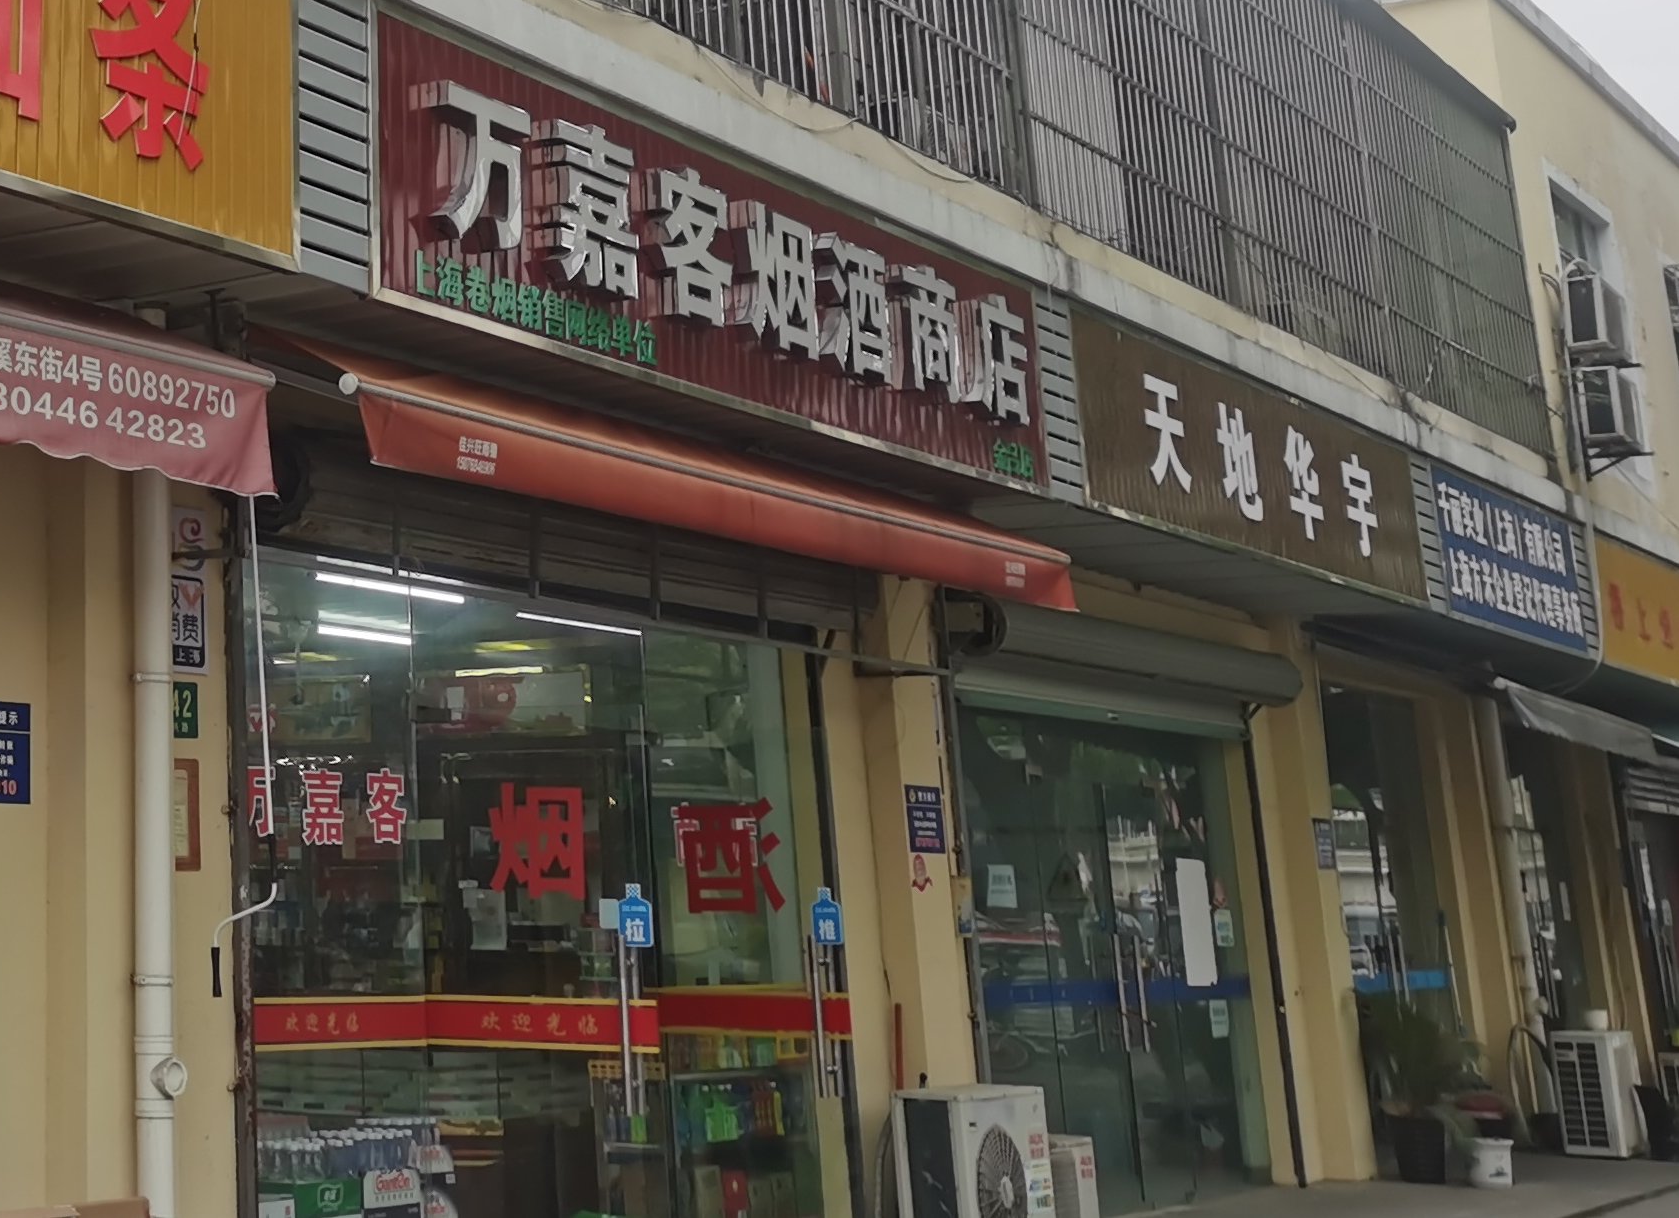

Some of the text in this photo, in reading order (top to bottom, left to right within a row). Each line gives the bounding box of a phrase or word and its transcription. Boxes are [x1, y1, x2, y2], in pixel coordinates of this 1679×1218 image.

[421, 80, 1032, 426] 万嘉客烟酒商店
[415, 249, 658, 366] 上海卷烟销售网络单位
[1142, 372, 1379, 559] 天地华宇
[489, 782, 586, 901] 烟
[625, 917, 646, 943] 拉
[818, 918, 836, 941] 推
[285, 1011, 360, 1035] 欢迎光临
[480, 1011, 599, 1037] 欢迎光临
